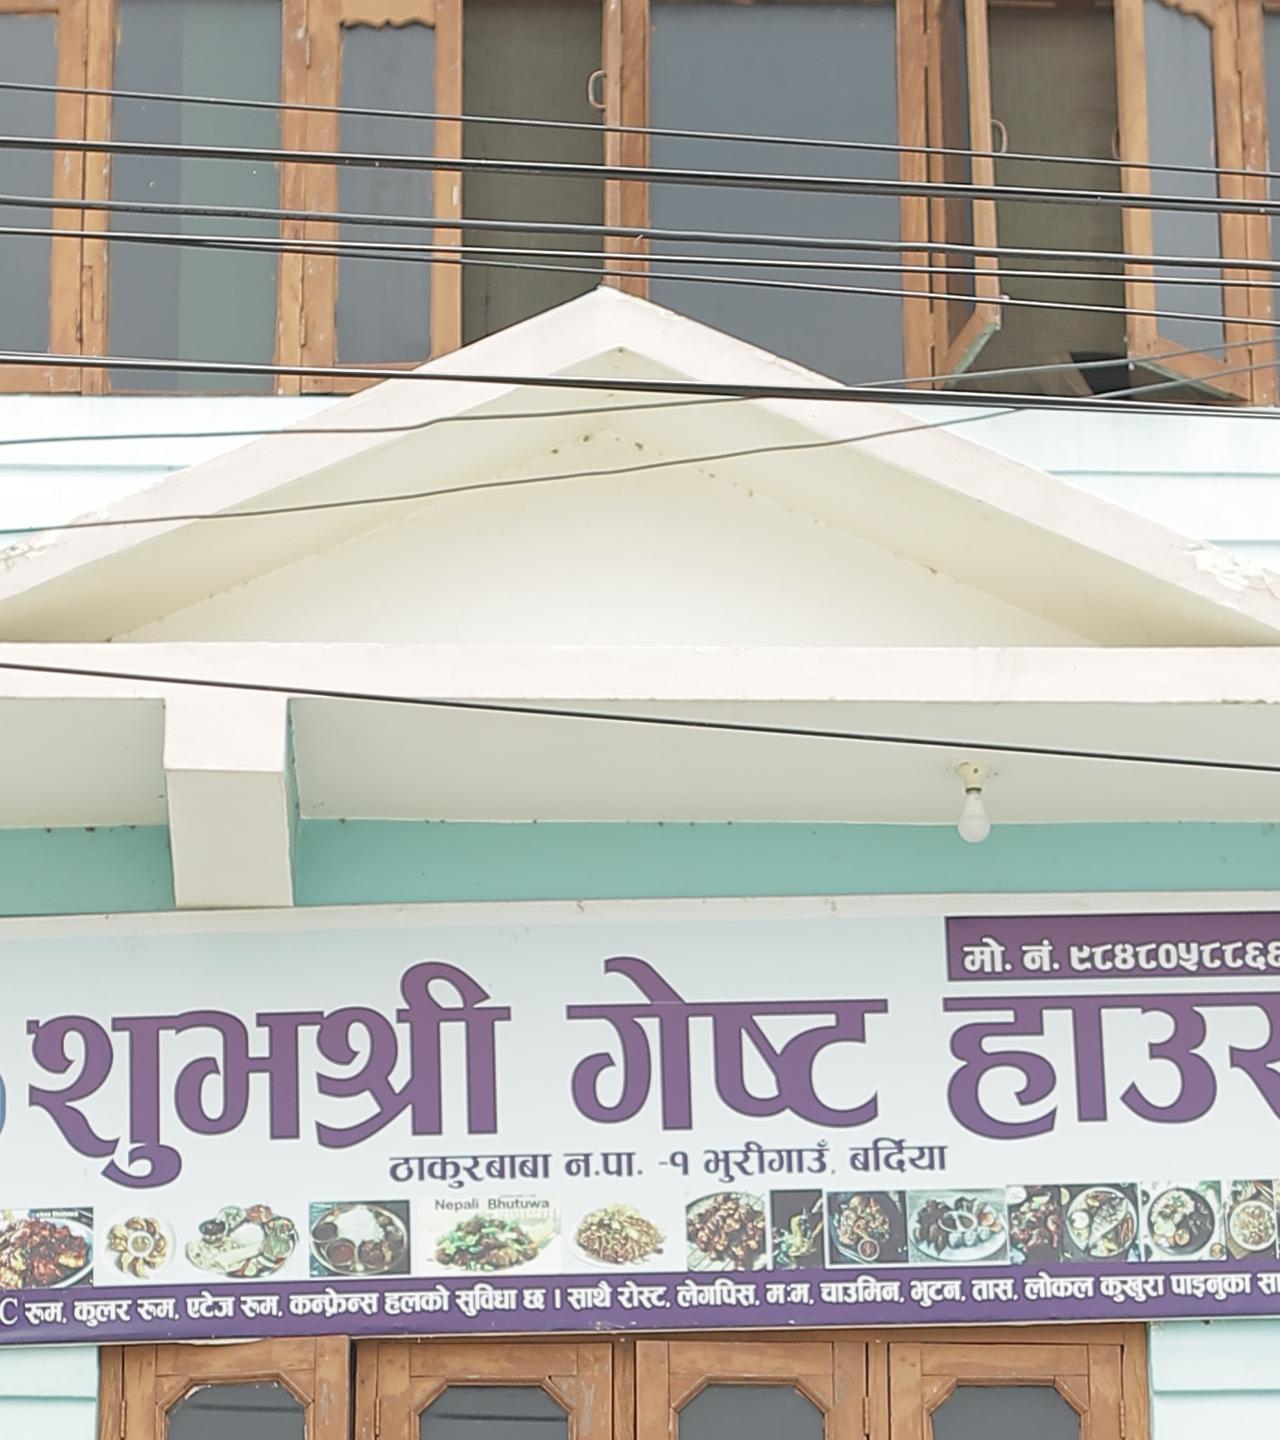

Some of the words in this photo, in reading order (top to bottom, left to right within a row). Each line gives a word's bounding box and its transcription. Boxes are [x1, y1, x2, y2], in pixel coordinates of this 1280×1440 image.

[963, 938, 1012, 972] मो.
[1022, 940, 1059, 971] नं.
[565, 954, 890, 1132] गेष्ट
[389, 1154, 552, 1189] ठाकुरबाबा
[564, 1152, 642, 1178] न.पा.
[850, 1137, 948, 1173] बर्दिया
[435, 1198, 479, 1212] Nepali
[488, 1195, 550, 1210] Bhutuwa
[74, 1300, 132, 1327] कुलर
[186, 1291, 235, 1318] एटेज
[384, 1285, 450, 1314] हलको
[455, 1283, 518, 1316] सुविधा
[523, 1289, 546, 1309] छ
[567, 1281, 612, 1310] साथै
[1024, 1272, 1095, 1299] लोकल
[1100, 1275, 1165, 1302] कुखुरा
[1170, 1273, 1252, 1300] पाइनुका
